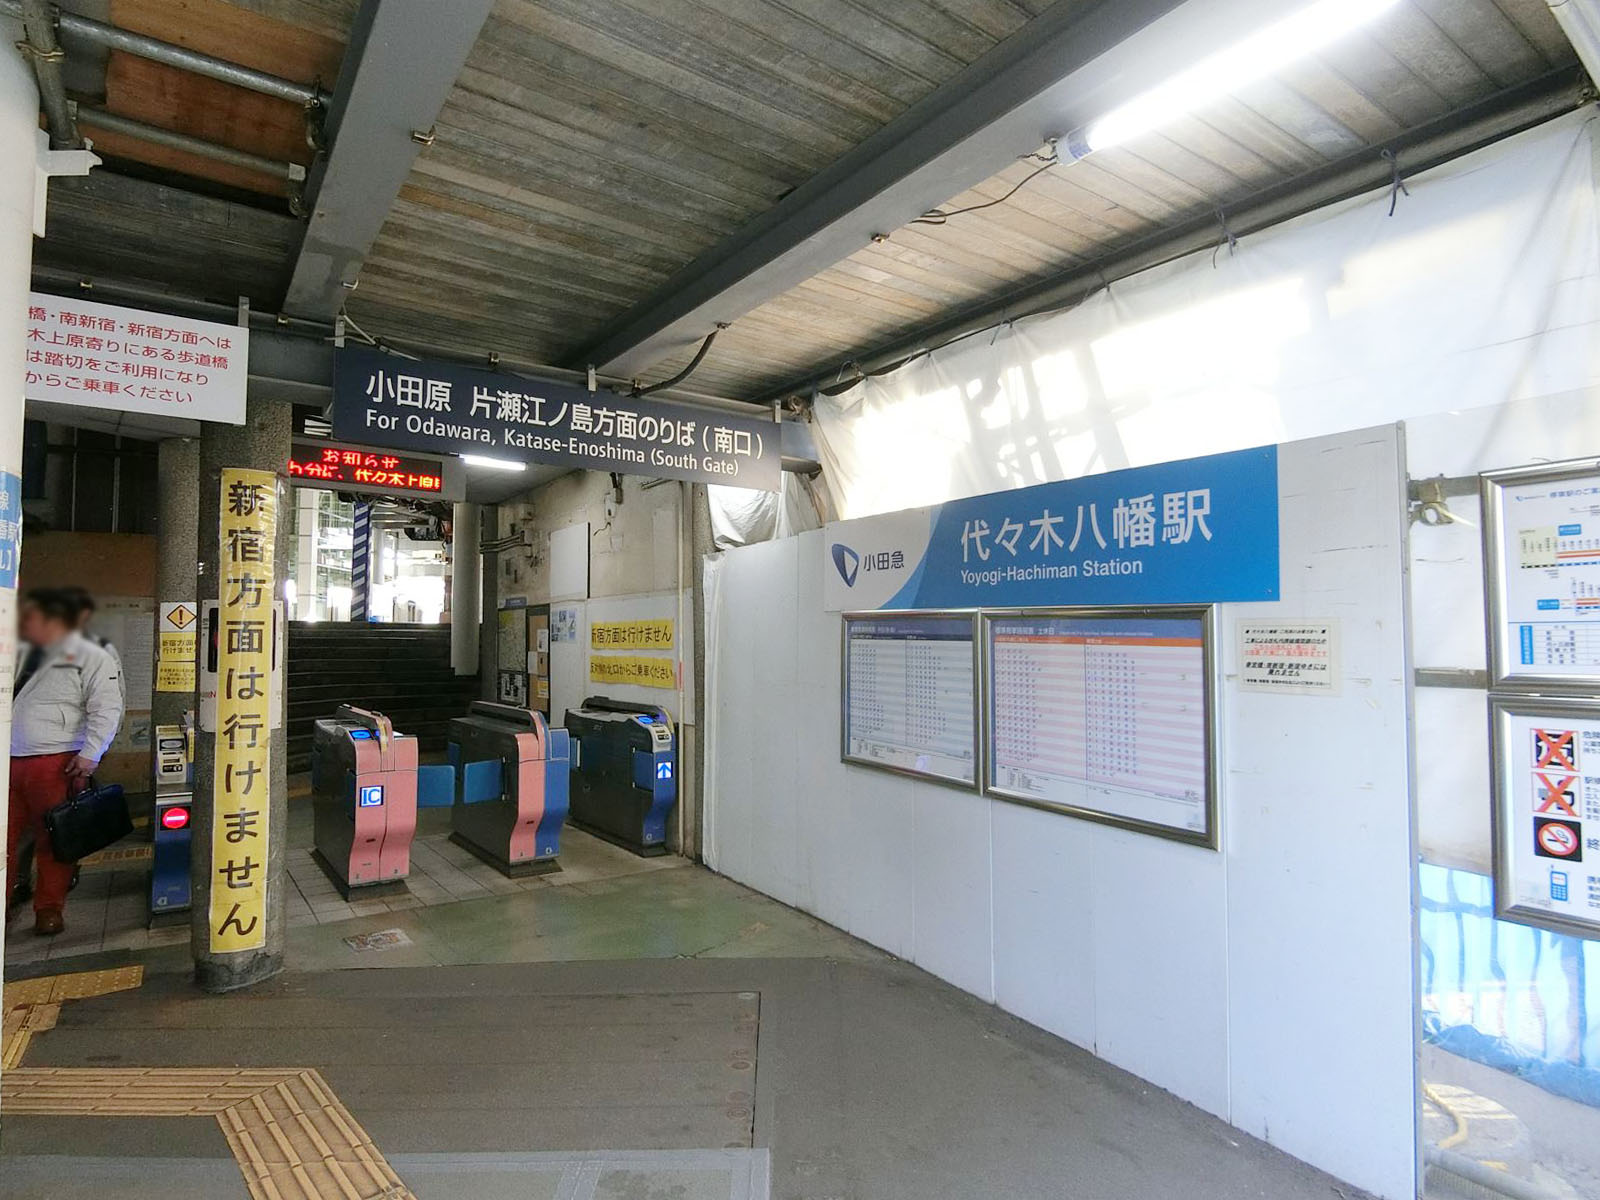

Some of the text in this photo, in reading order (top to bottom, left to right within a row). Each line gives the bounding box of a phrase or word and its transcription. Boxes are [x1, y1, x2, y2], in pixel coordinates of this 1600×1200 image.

[26, 349, 209, 386] は踏切をご利用になり
[27, 328, 229, 370] 木上原寄りにある歩道橋
[25, 370, 193, 403] からご乗車ください
[366, 370, 452, 412] 小田原
[322, 450, 400, 470] お知らせ
[366, 410, 740, 476] For Odawara, Katase-Enoshima (South Gate)
[961, 488, 1213, 563] 代々木八幡駅
[863, 551, 905, 572] 小田急
[961, 559, 1143, 586] Yoyogi-Hachiman Station
[219, 480, 267, 937] 新宿方面は行けません
[362, 788, 381, 805] IC
